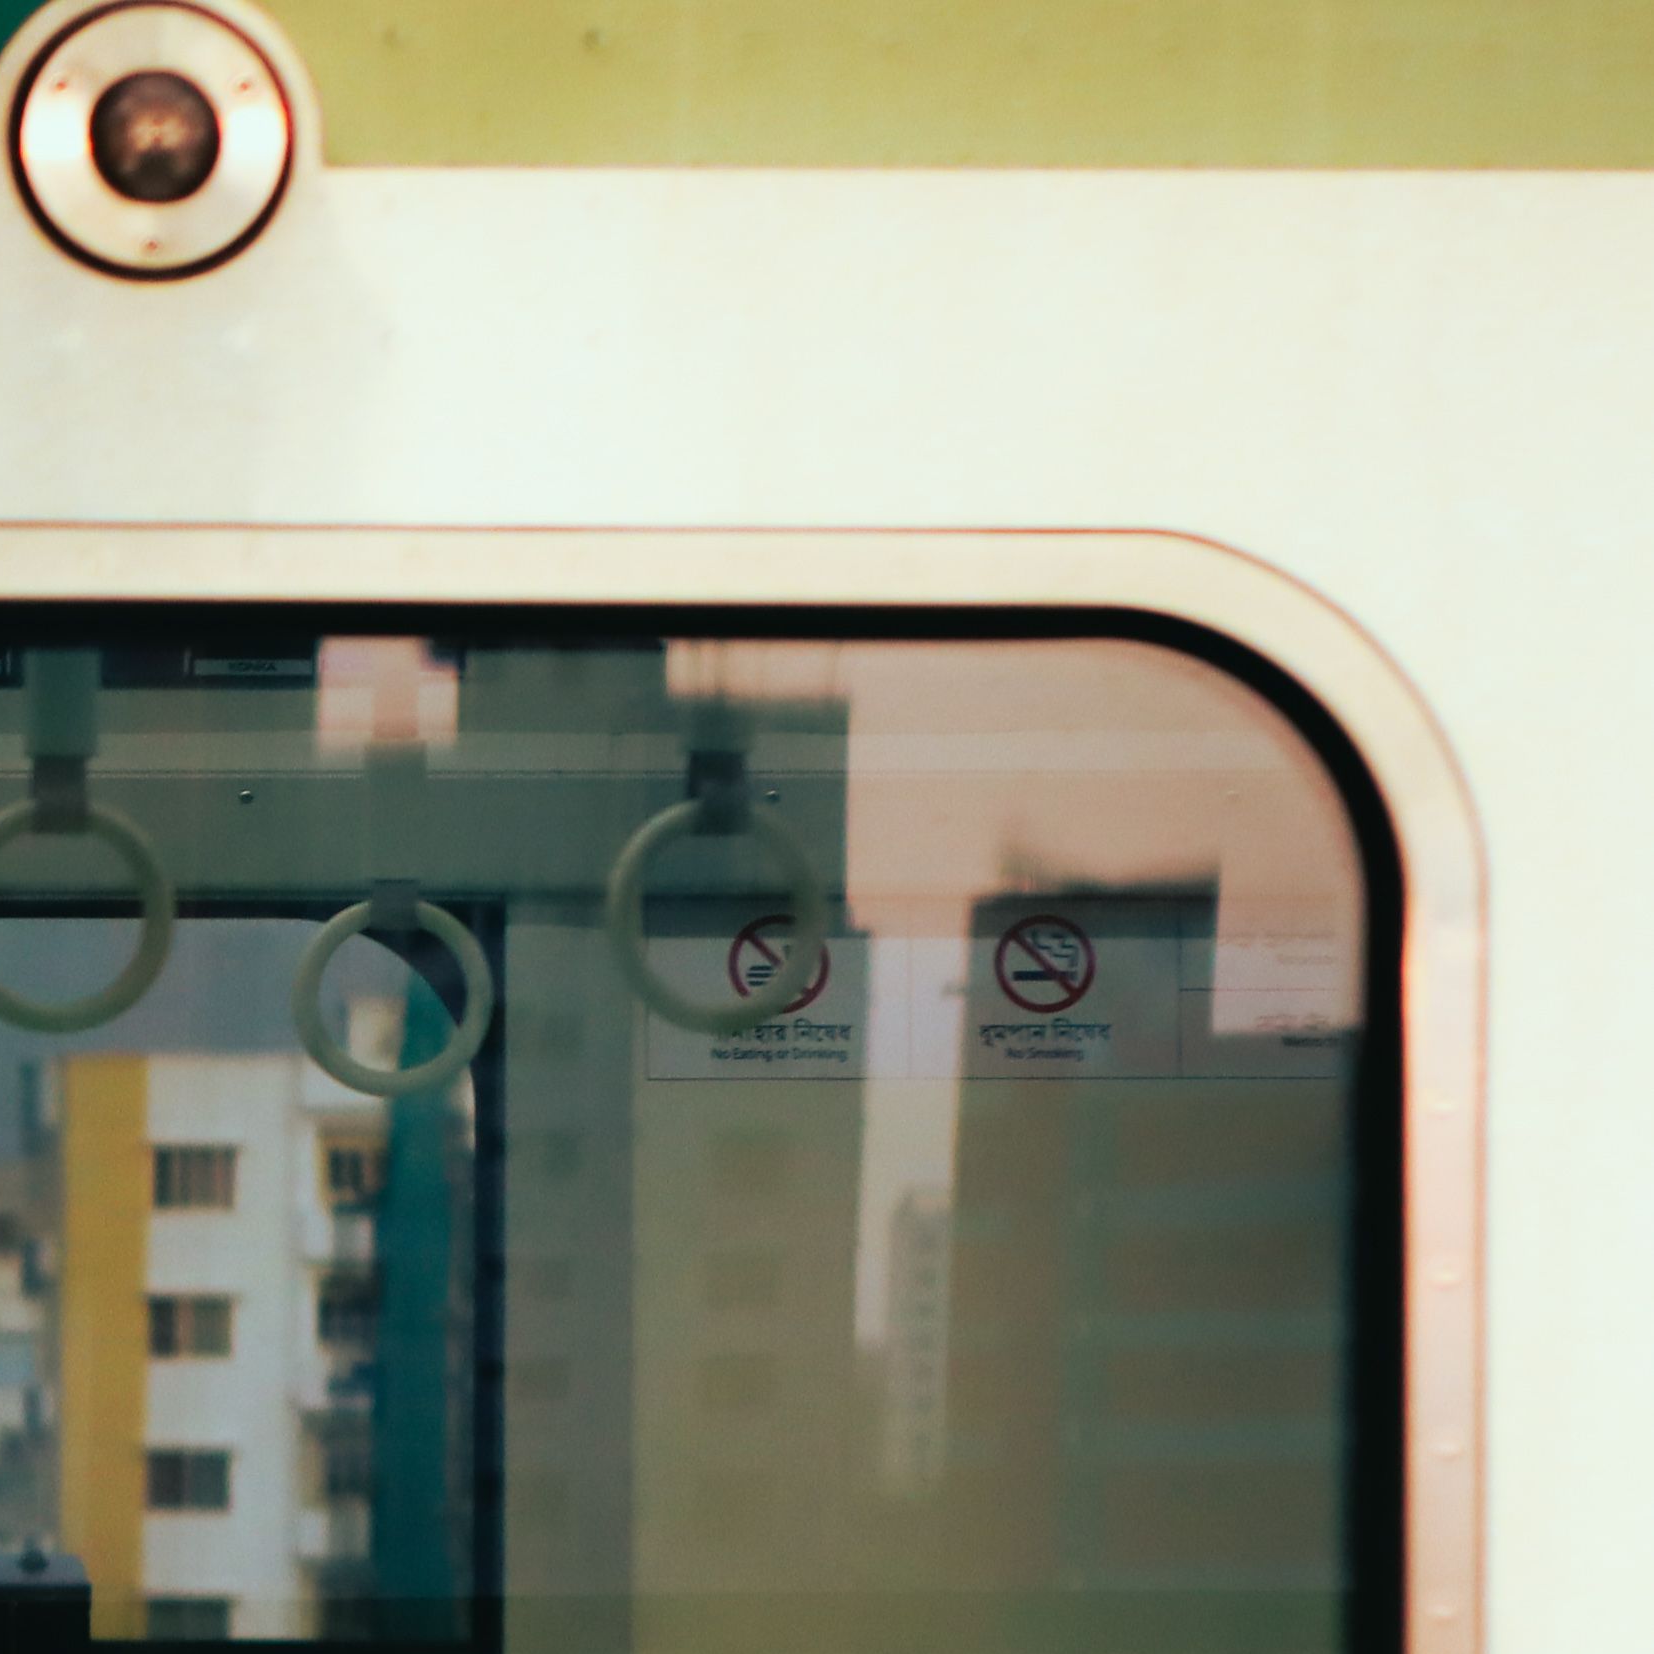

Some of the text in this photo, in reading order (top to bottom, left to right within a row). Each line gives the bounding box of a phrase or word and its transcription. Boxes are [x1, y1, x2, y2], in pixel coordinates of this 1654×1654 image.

[710, 1048, 730, 1060] No
[732, 1047, 774, 1063] Eating
[792, 1047, 849, 1063] Drinking
[1005, 1047, 1084, 1062] No Smoking
